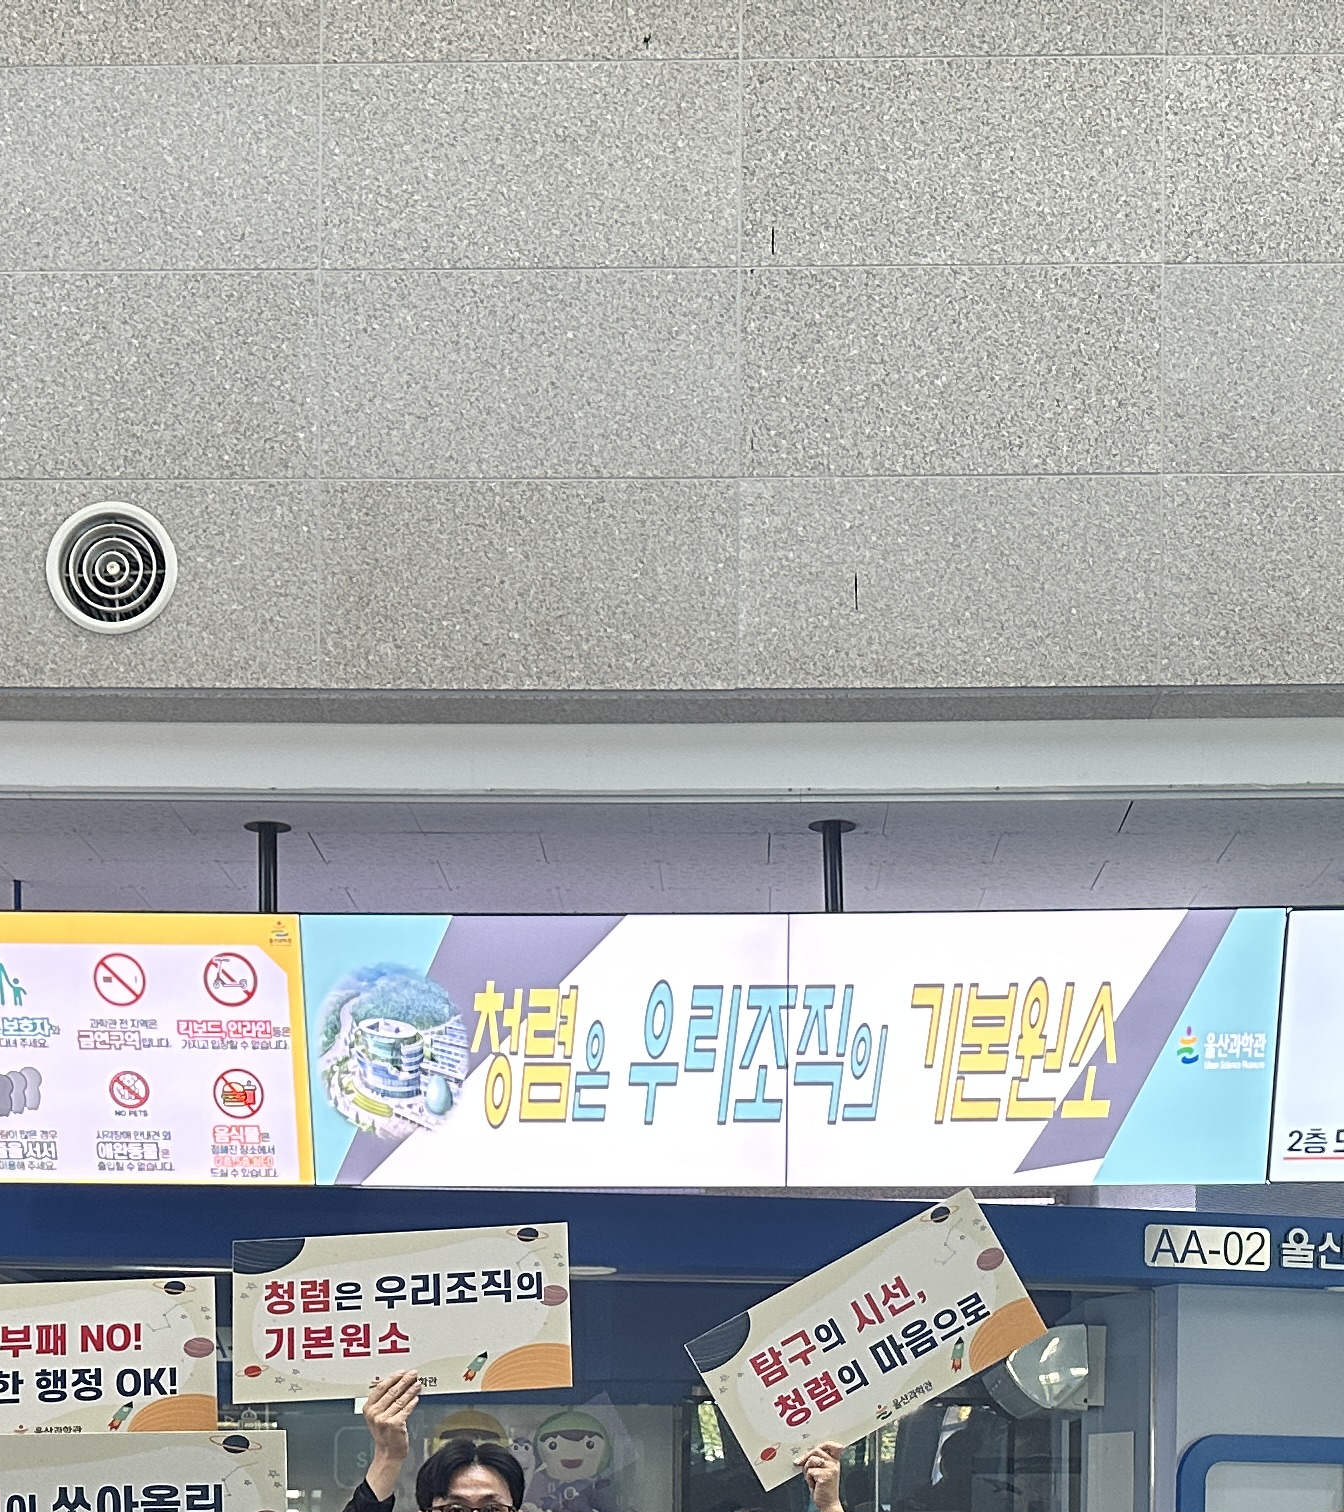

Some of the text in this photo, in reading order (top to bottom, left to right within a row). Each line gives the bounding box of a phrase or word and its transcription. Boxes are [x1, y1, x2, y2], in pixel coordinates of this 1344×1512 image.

[176, 1019, 226, 1039] 킥보드,
[1203, 1032, 1268, 1059] 울산과학관
[472, 976, 1118, 1130] 청렴은 우리조직의 기본원소
[1287, 1128, 1329, 1154] 2층
[1150, 1228, 1266, 1266] AA-02
[263, 1270, 545, 1316] 청렴은 우리조직의
[79, 1323, 143, 1353] NO!
[263, 1323, 412, 1362] 기본원소
[748, 1276, 928, 1389] 탐구의 시선,
[774, 1292, 991, 1429] 청렴의 마음으로
[34, 1370, 104, 1404] 행정
[115, 1368, 179, 1398] OK!
[892, 1380, 933, 1410] 울산과학관
